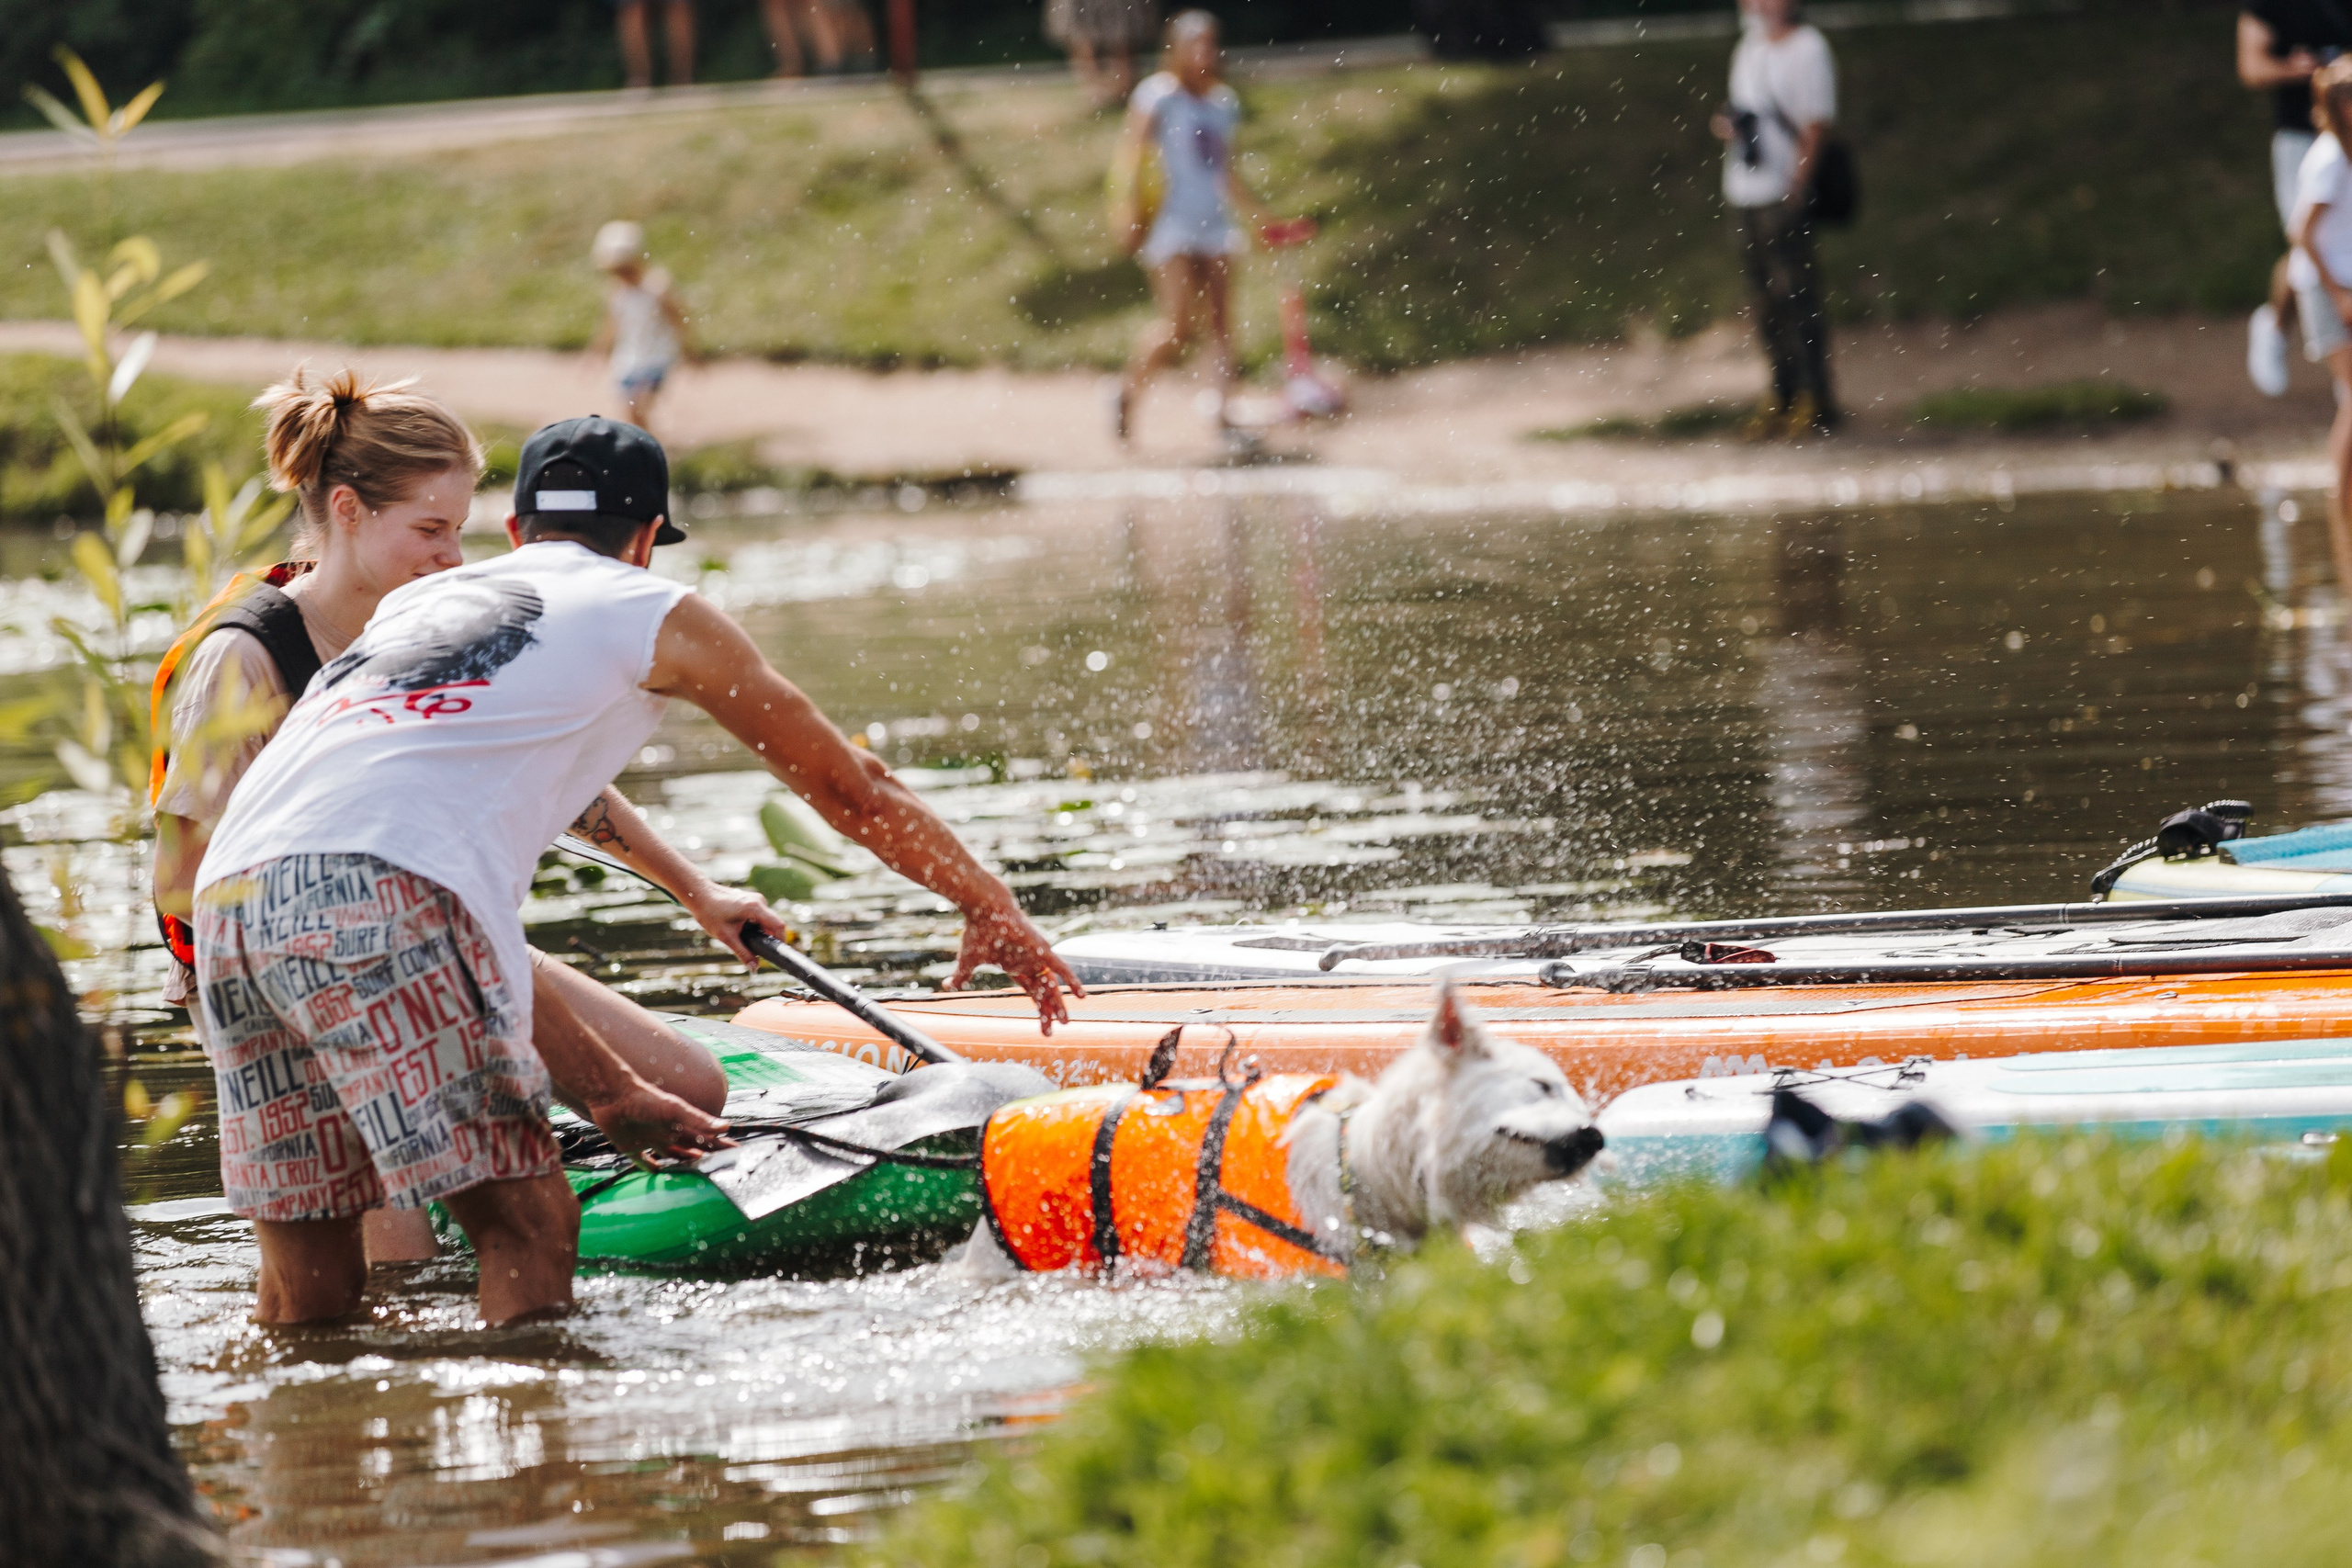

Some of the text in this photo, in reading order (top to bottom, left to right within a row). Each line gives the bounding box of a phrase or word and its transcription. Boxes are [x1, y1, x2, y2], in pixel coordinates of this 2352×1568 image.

[334, 926, 378, 957] SURF
[306, 983, 361, 1032] 1952
[222, 1049, 304, 1113] NEILL
[390, 1037, 454, 1108] EST.
[221, 1091, 312, 1155] ST. 1952
[275, 1158, 322, 1188] CRUZ
